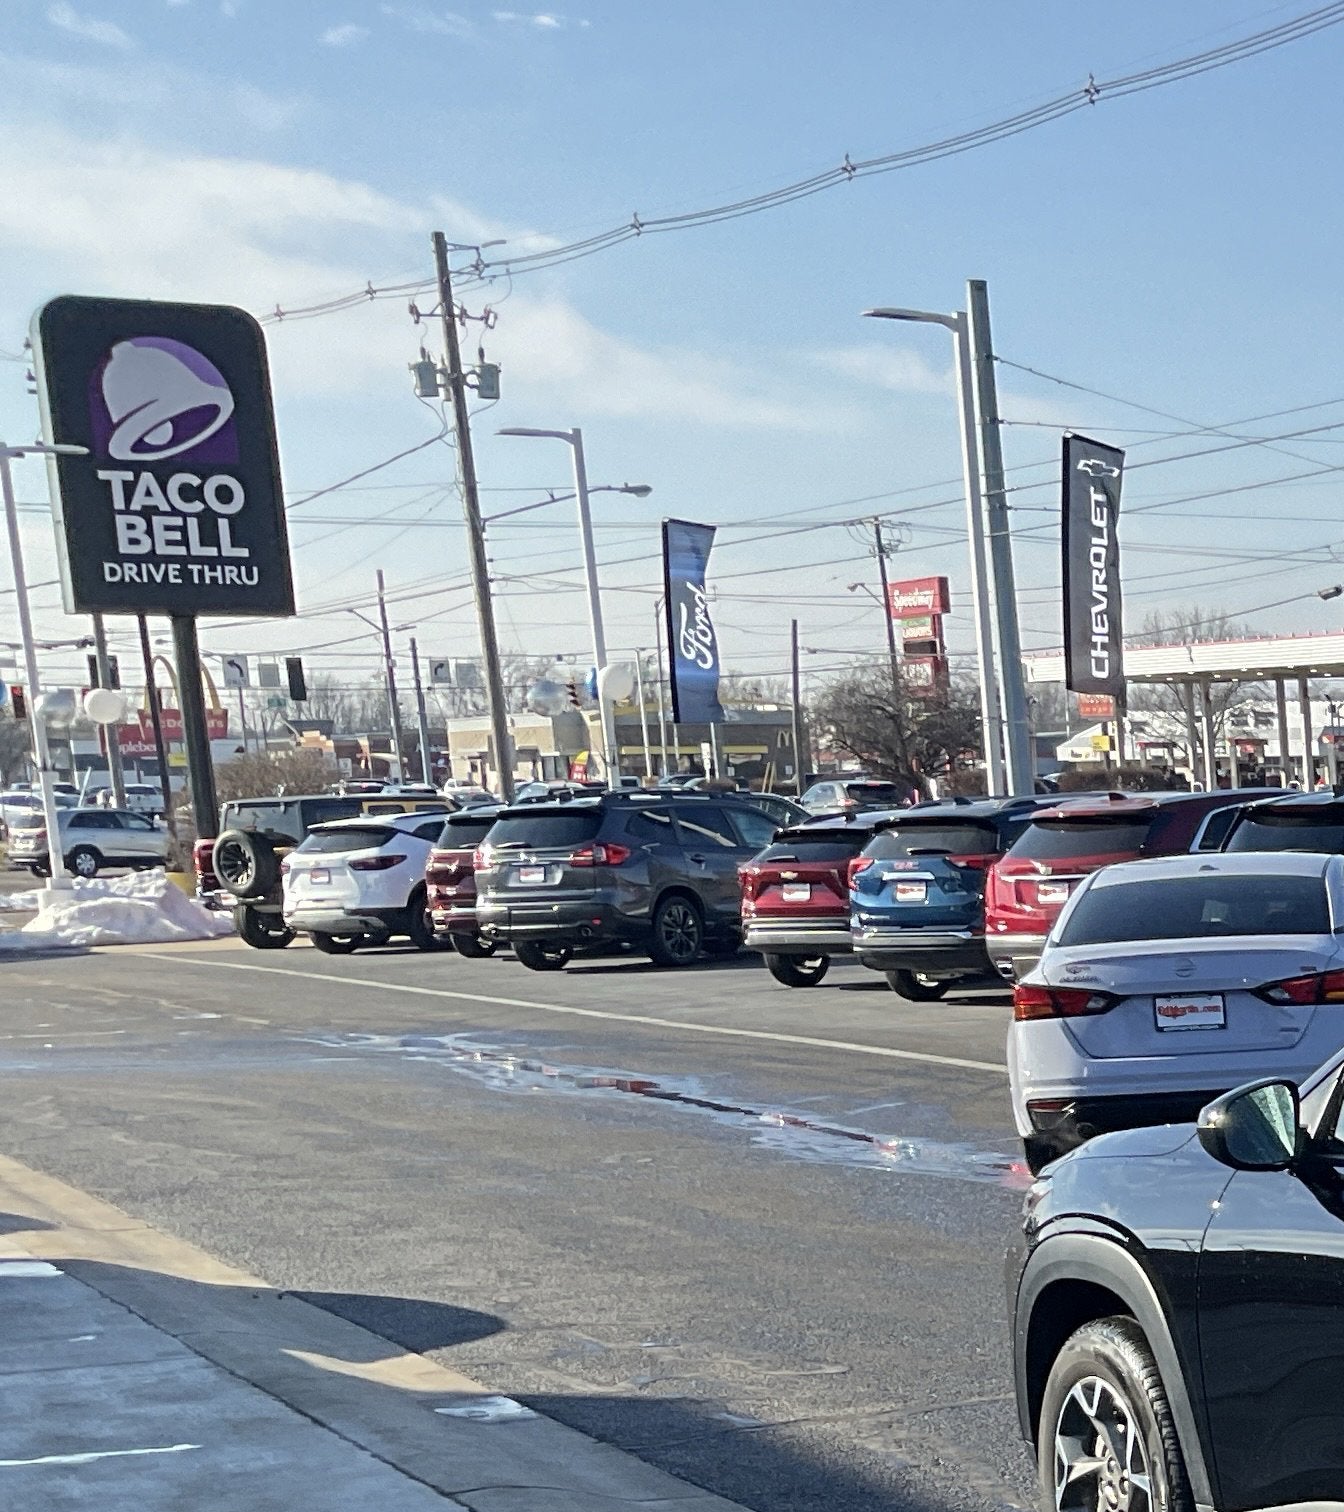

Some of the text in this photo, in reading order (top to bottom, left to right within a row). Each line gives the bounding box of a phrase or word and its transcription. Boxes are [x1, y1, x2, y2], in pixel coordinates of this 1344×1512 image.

[97, 470, 245, 515] TACO
[115, 514, 250, 558] BELL
[103, 562, 259, 586] DRIVE THRU
[1089, 486, 1110, 680] CHEVROLET
[680, 581, 713, 670] Ford
